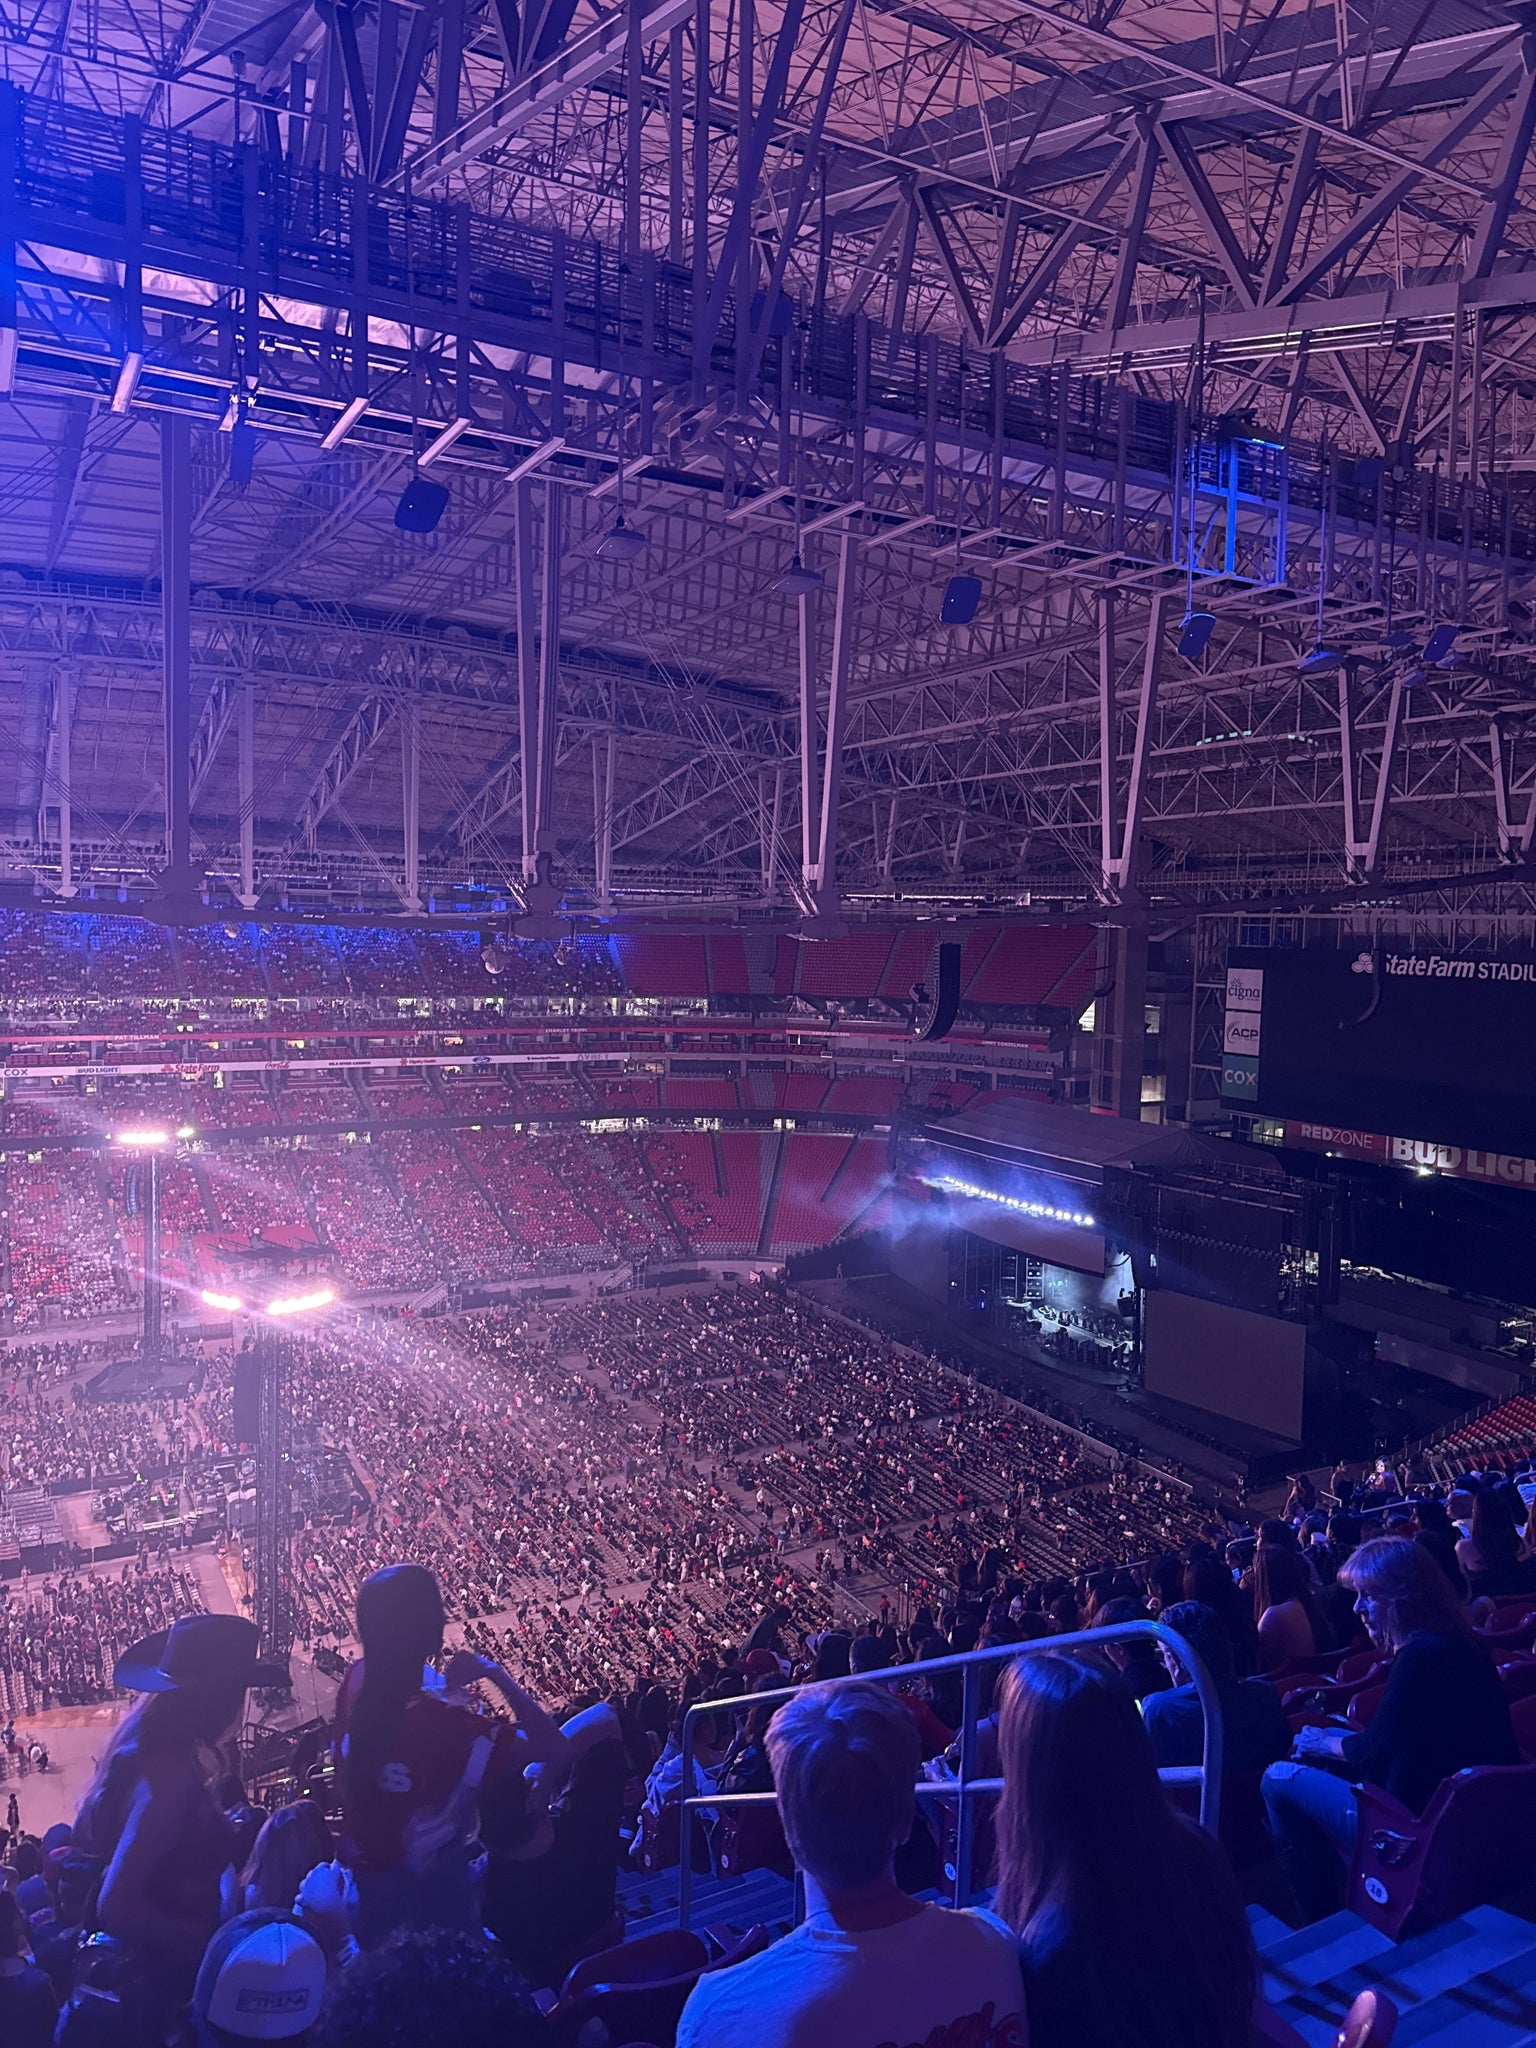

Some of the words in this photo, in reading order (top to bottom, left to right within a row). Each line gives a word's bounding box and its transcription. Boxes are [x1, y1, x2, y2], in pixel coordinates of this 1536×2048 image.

[1228, 986, 1260, 1000] cigna
[1231, 1027, 1259, 1039] ACP
[1224, 1069, 1256, 1085] COX
[1301, 1124, 1373, 1149] REDZONE
[1393, 1137, 1461, 1169] BUD
